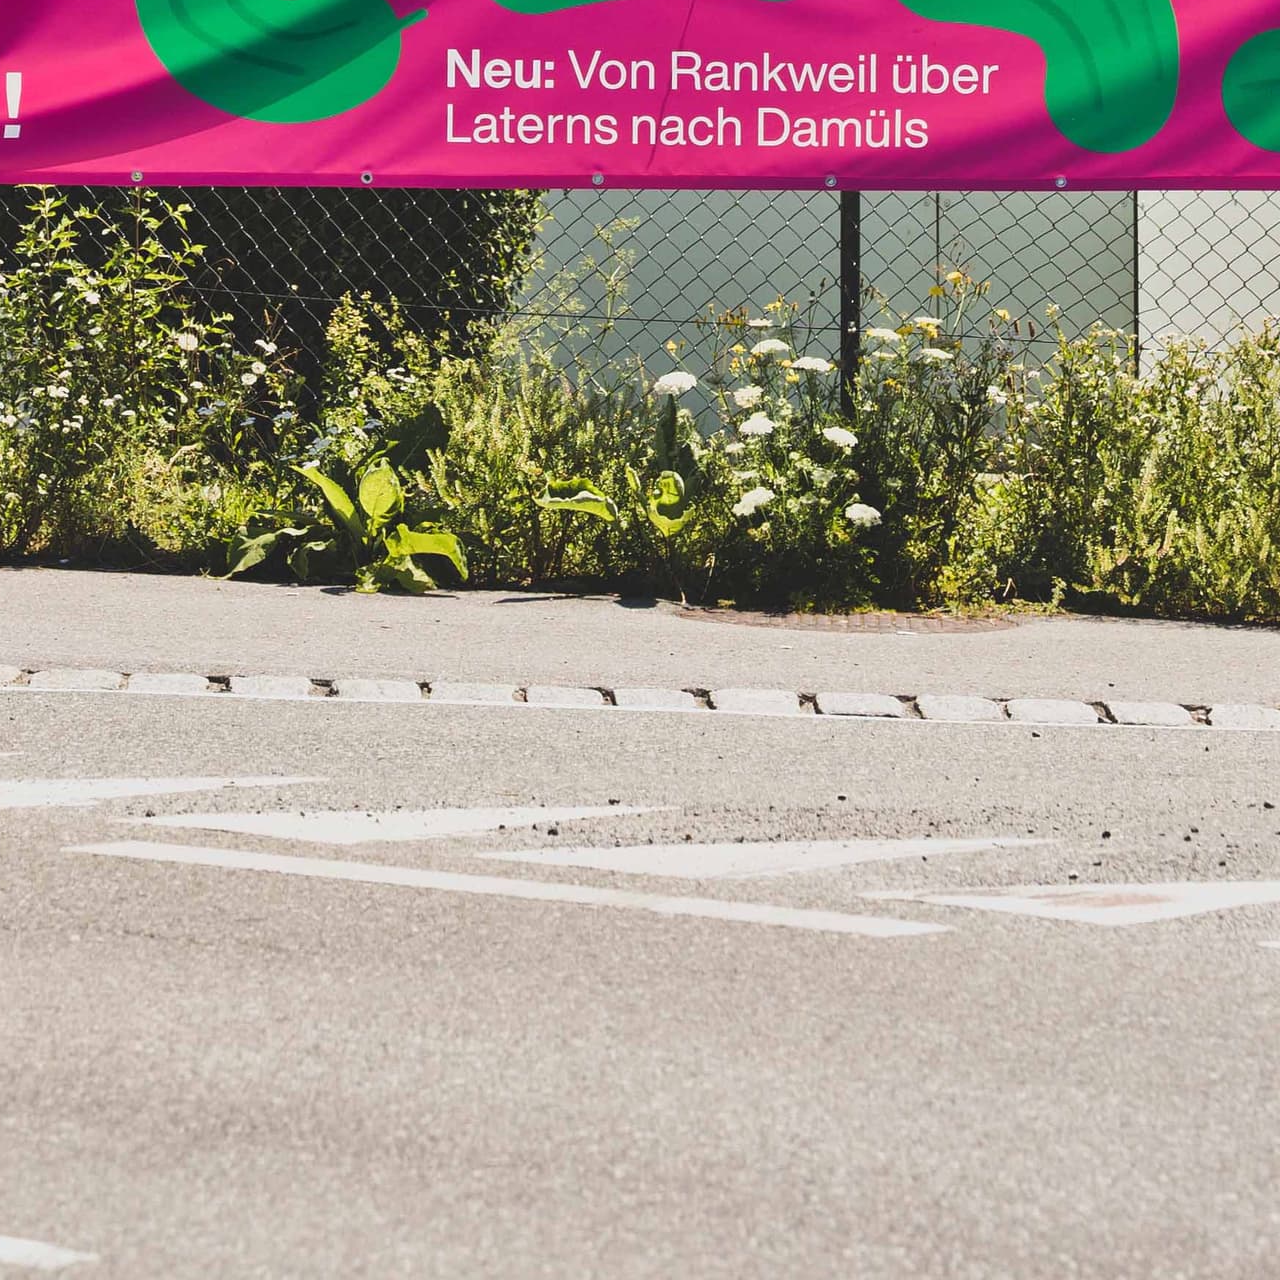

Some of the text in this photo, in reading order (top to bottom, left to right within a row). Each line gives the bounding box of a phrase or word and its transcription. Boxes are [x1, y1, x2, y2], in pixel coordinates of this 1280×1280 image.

[446, 48, 1000, 95] Neu: Von Rankweil über
[446, 103, 930, 149] Laterns nach Damüls
